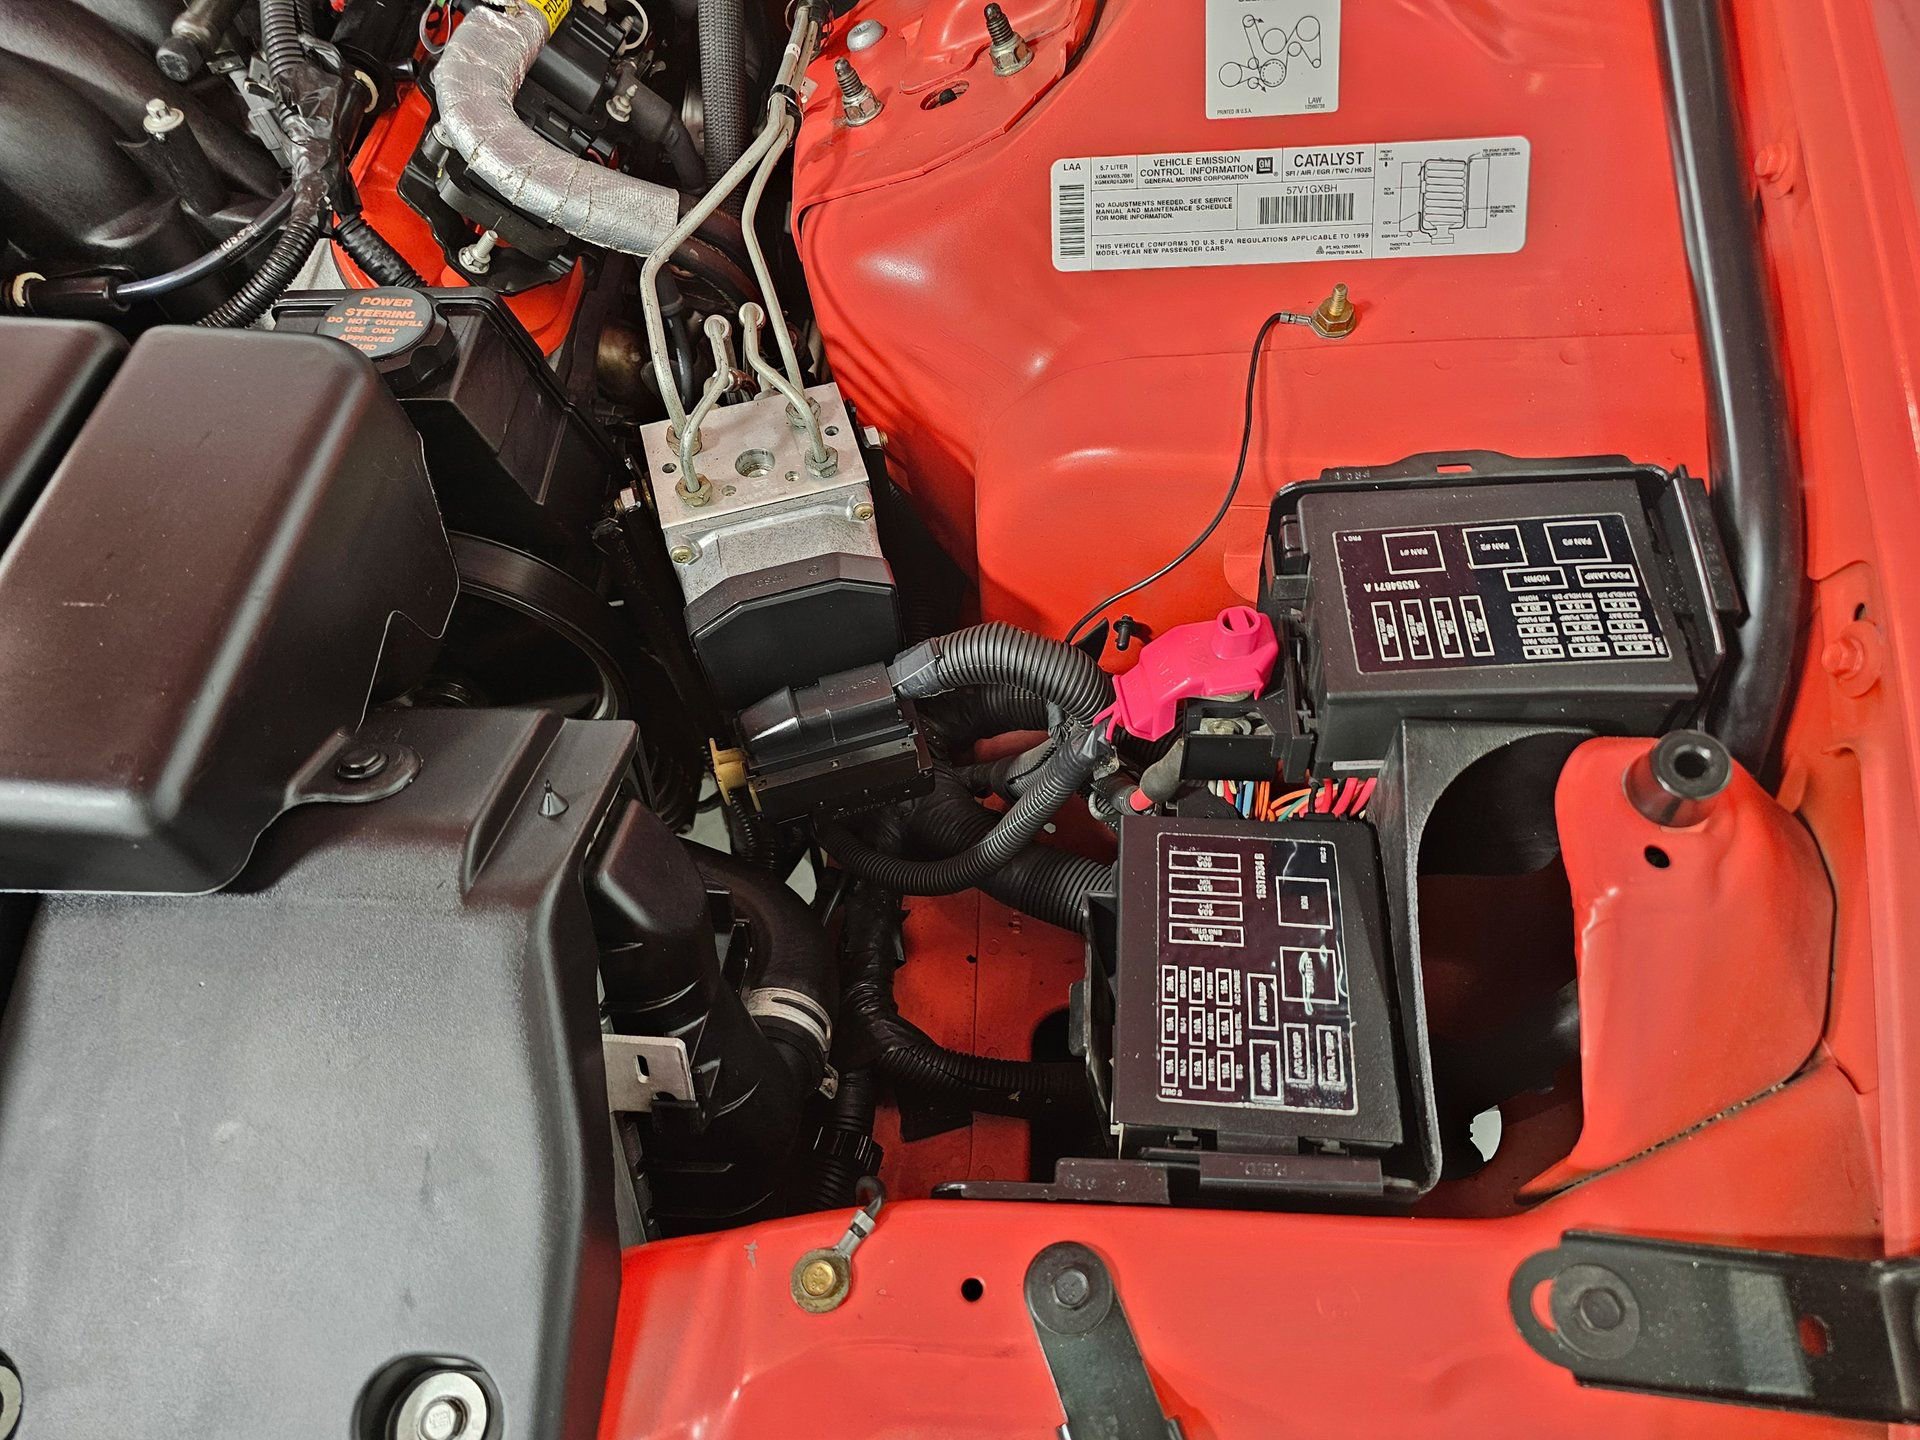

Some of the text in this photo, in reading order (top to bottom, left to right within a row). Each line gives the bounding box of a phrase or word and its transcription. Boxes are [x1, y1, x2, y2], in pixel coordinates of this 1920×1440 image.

[1153, 156, 1241, 167] VEHICLE EMISSION
[1294, 152, 1364, 168] CATALYST
[1063, 163, 1081, 171] LAA
[1140, 165, 1254, 177] CONTROL INFORMATION
[1144, 205, 1193, 213] MAINTENANCE
[1196, 203, 1233, 211] SCHEDULE
[360, 297, 414, 307] POWER
[345, 308, 417, 319] STEERING
[375, 319, 424, 327] OVERFILL
[372, 327, 400, 335] ONLY
[339, 334, 395, 343] APPROVED
[1492, 542, 1509, 550] FAN
[1584, 572, 1609, 580] LAMP
[1301, 896, 1309, 910] IGN
[1193, 978, 1201, 993] 15A
[1220, 979, 1228, 995] 15A
[1233, 970, 1241, 993] CRUISE
[1258, 981, 1268, 1022] AIR PUMP
[1221, 1020, 1230, 1036] 15A
[1292, 1031, 1302, 1058] COMP
